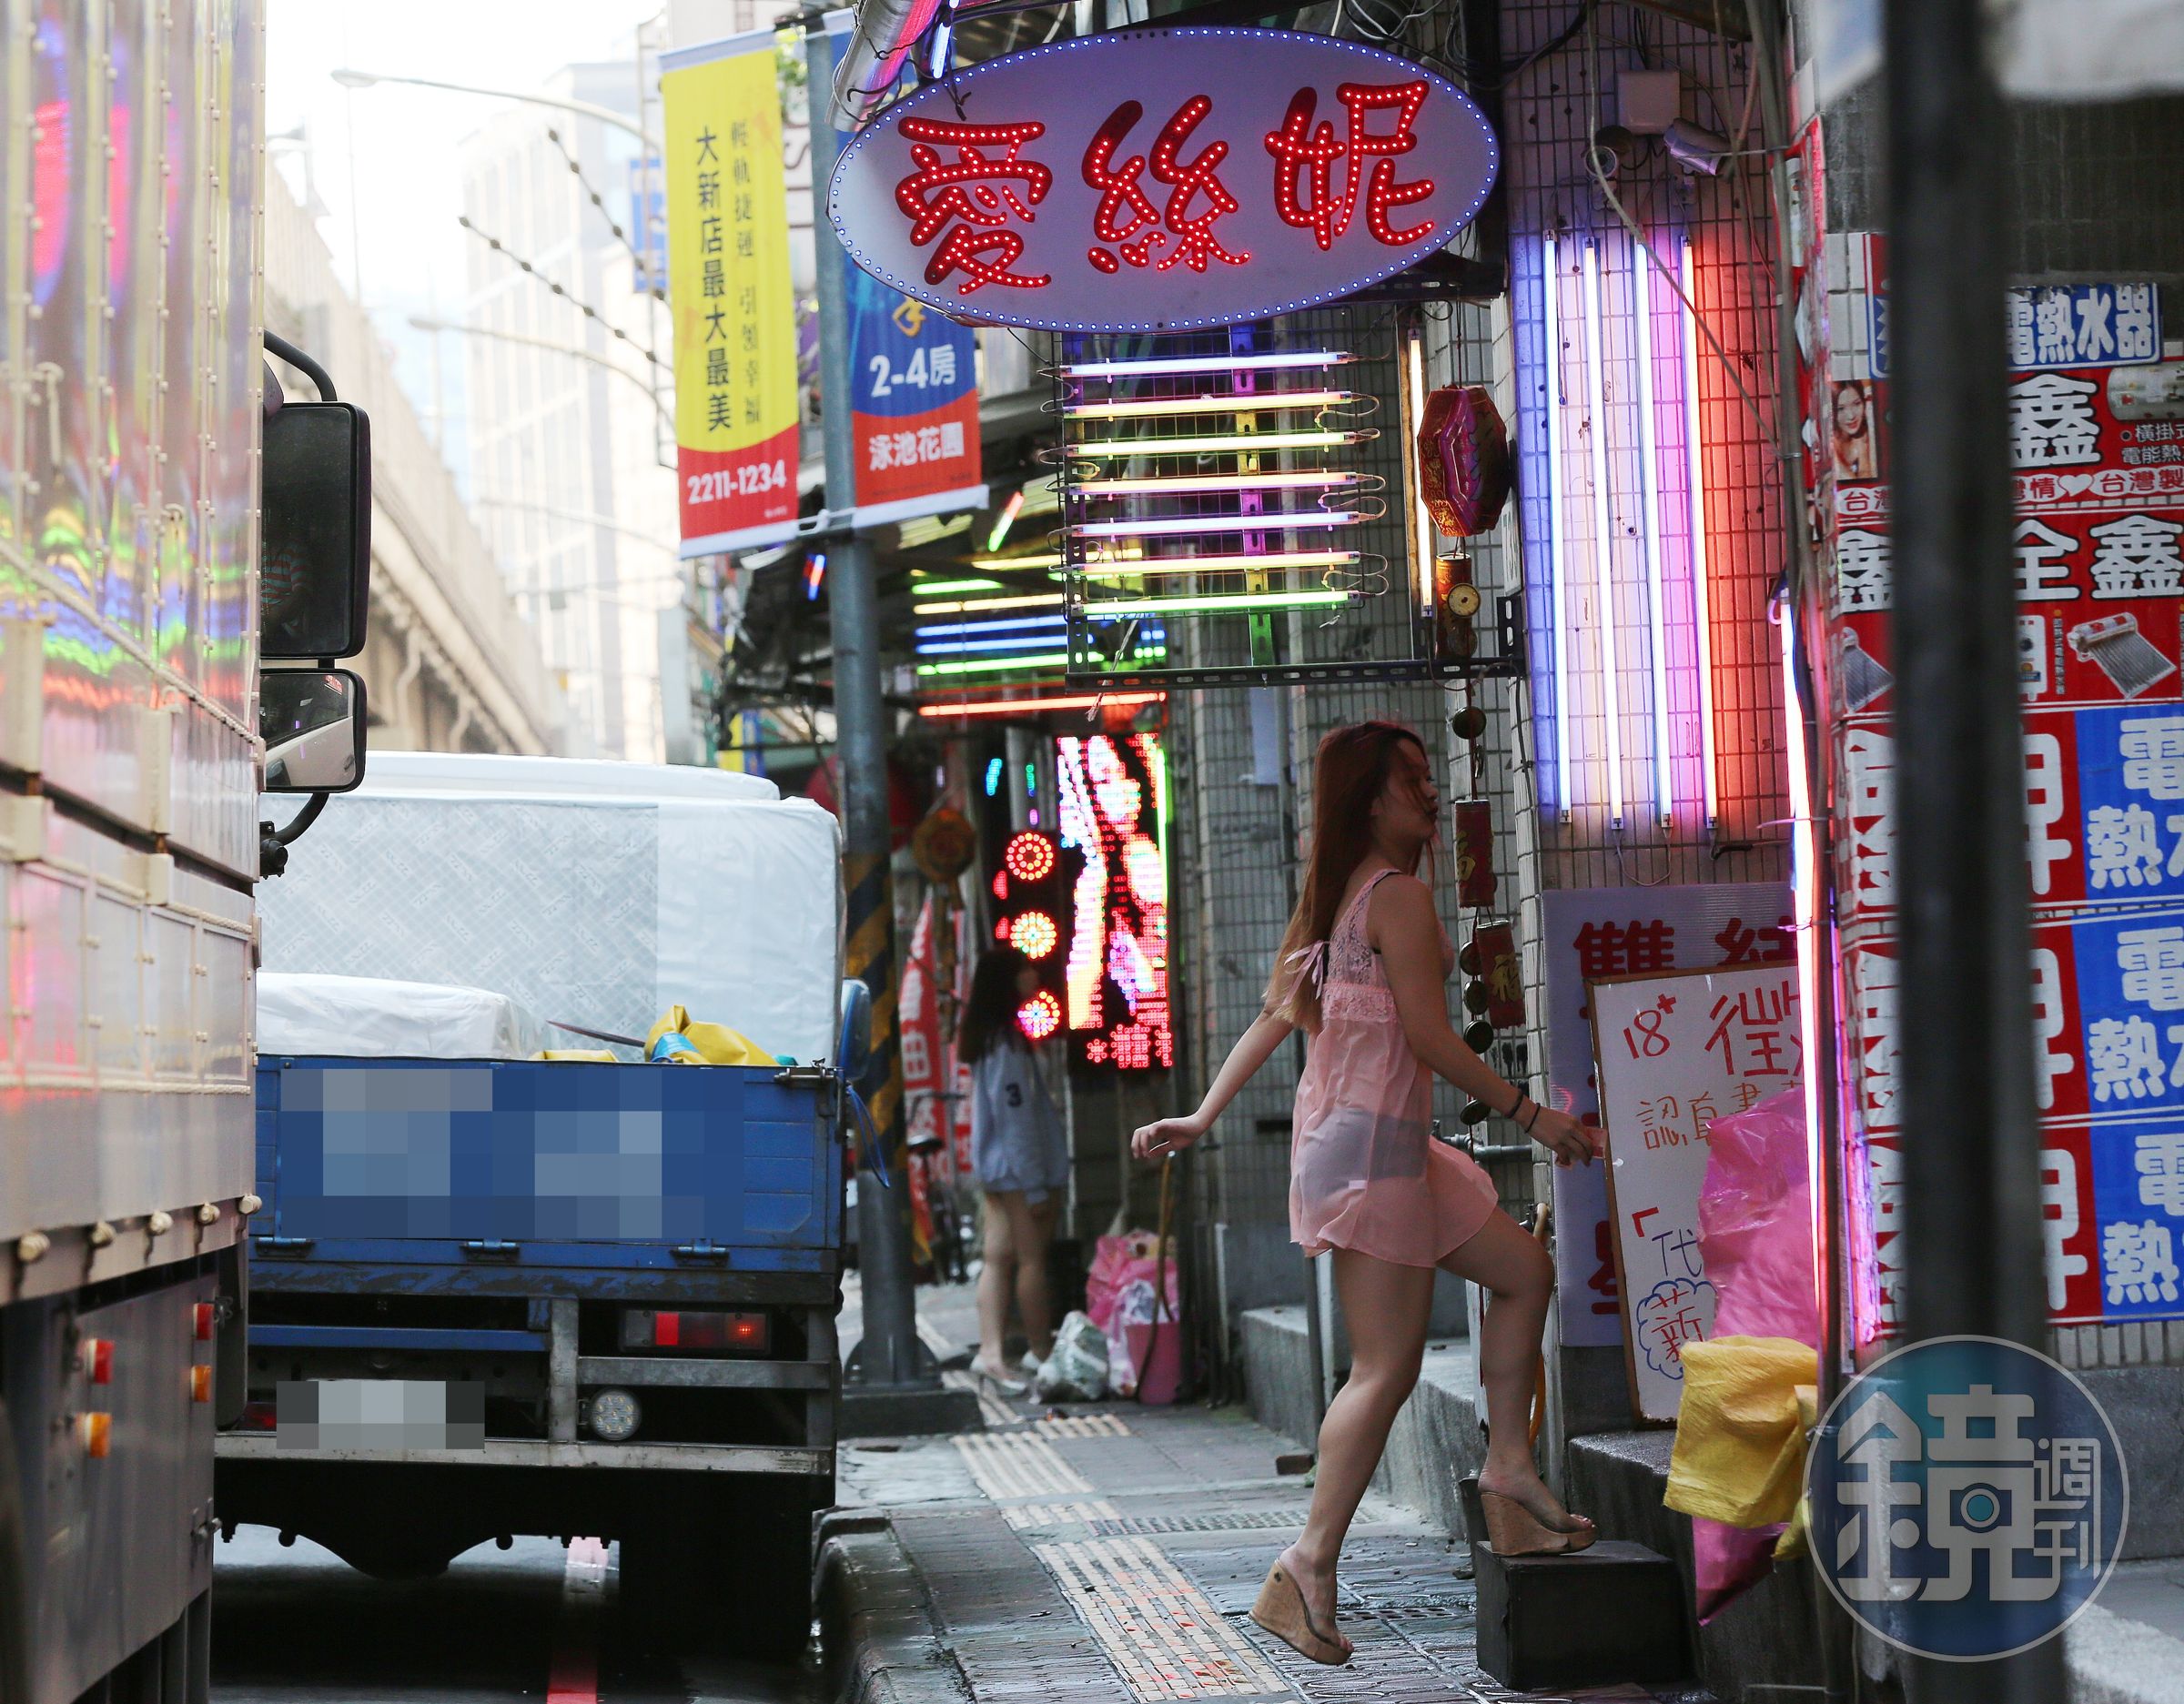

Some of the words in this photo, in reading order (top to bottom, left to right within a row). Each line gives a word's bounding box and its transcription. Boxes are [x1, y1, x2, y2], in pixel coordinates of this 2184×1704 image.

[895, 79, 1435, 295] 愛絲妮
[696, 126, 732, 431] 大新店最大最美
[869, 343, 956, 398] 2-4房
[868, 421, 965, 471] 泳池花園
[2121, 444, 2184, 465] 電能熱
[2135, 422, 2184, 443] 橫掛
[687, 459, 786, 505] 2211-1234
[2088, 803, 2184, 889] 熱
[2088, 1014, 2184, 1104] 熱
